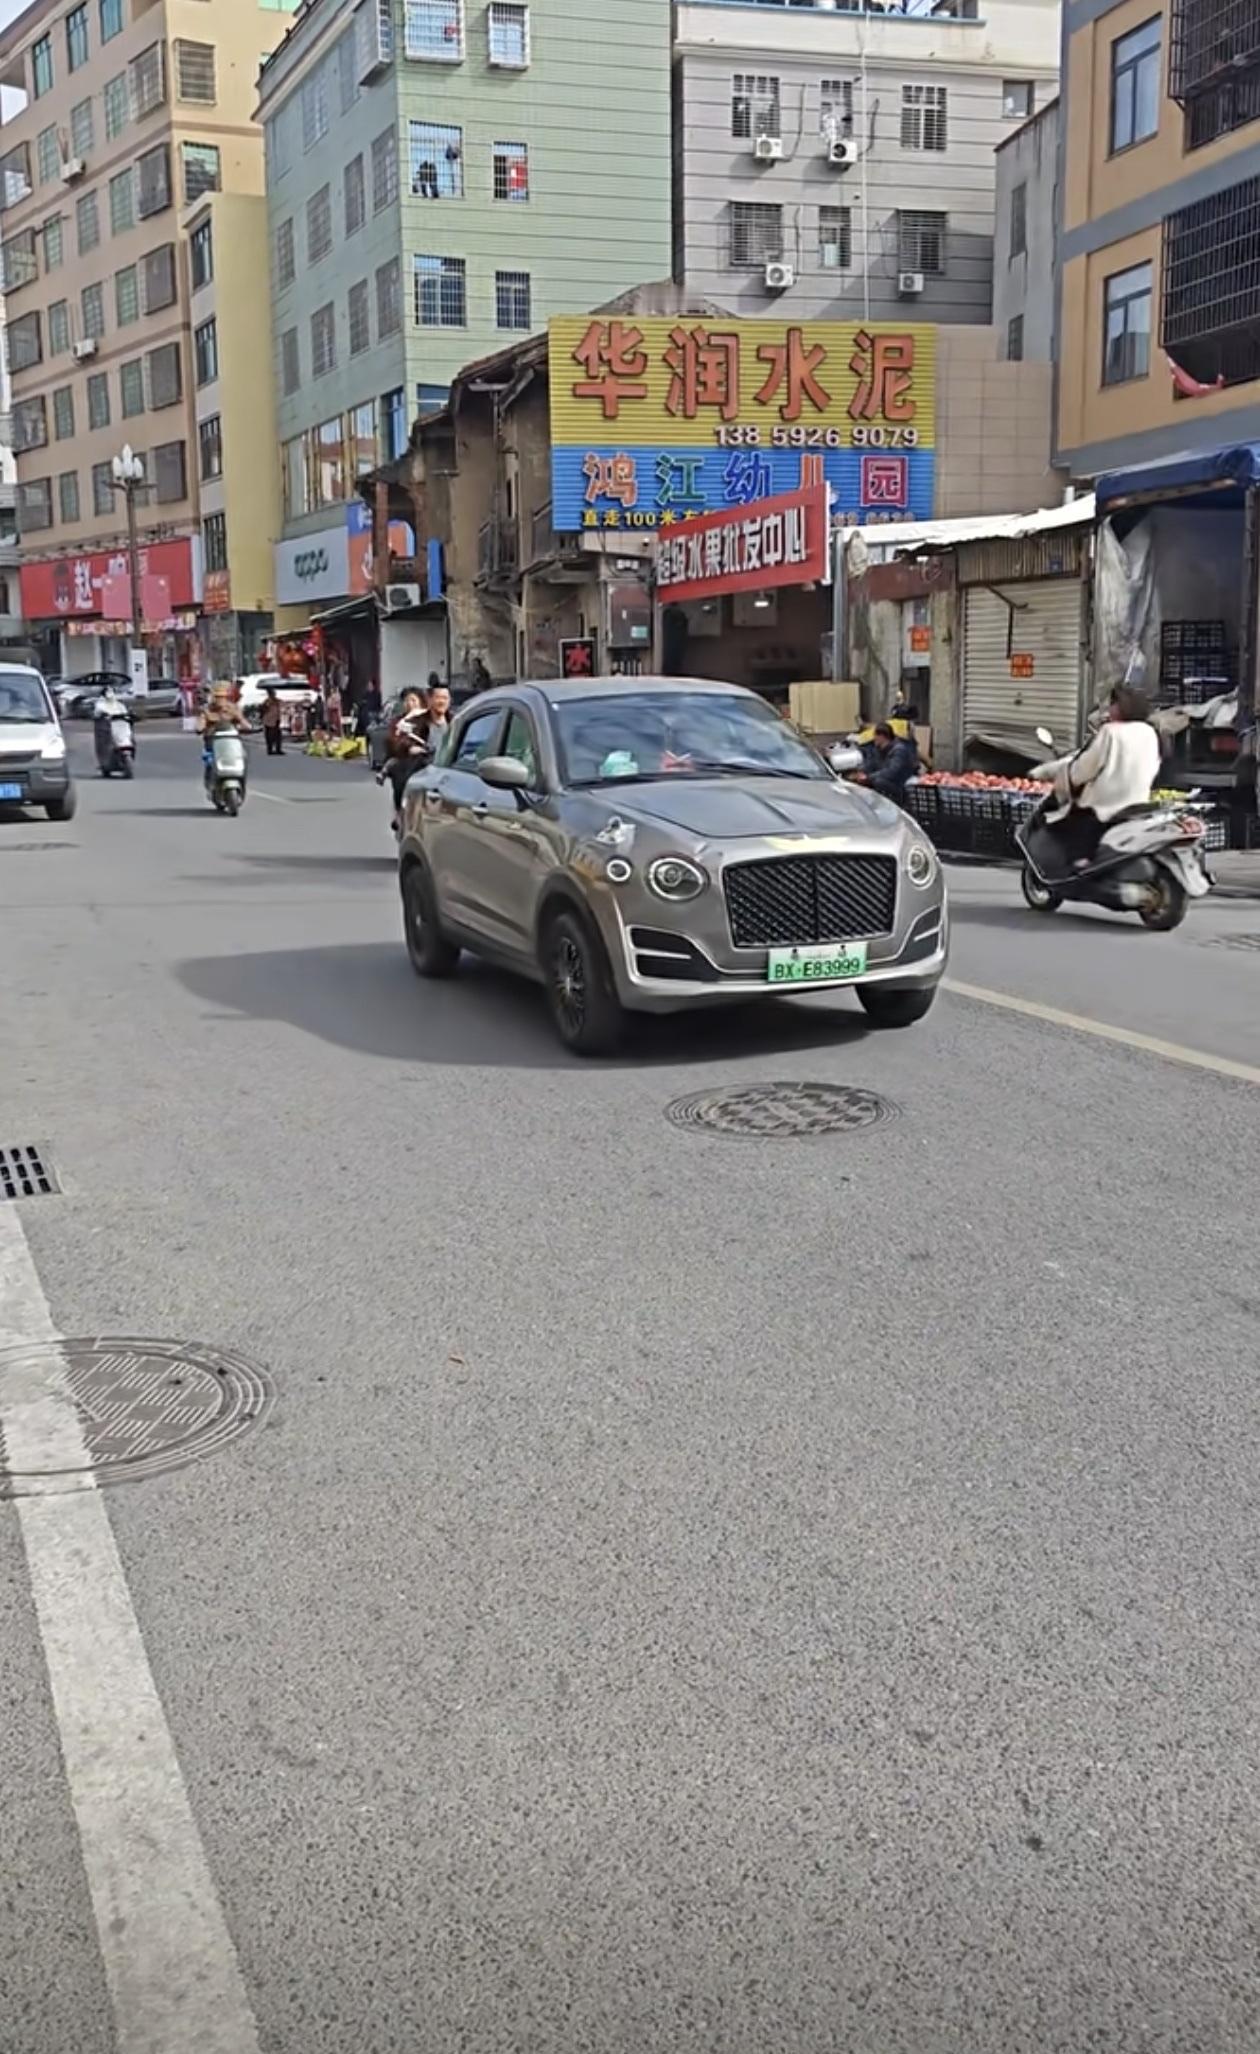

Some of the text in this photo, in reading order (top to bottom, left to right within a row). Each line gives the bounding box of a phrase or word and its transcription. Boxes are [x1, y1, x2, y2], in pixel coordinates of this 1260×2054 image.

[573, 320, 917, 421] 华润水泥
[714, 425, 919, 447] 138 5926 9079
